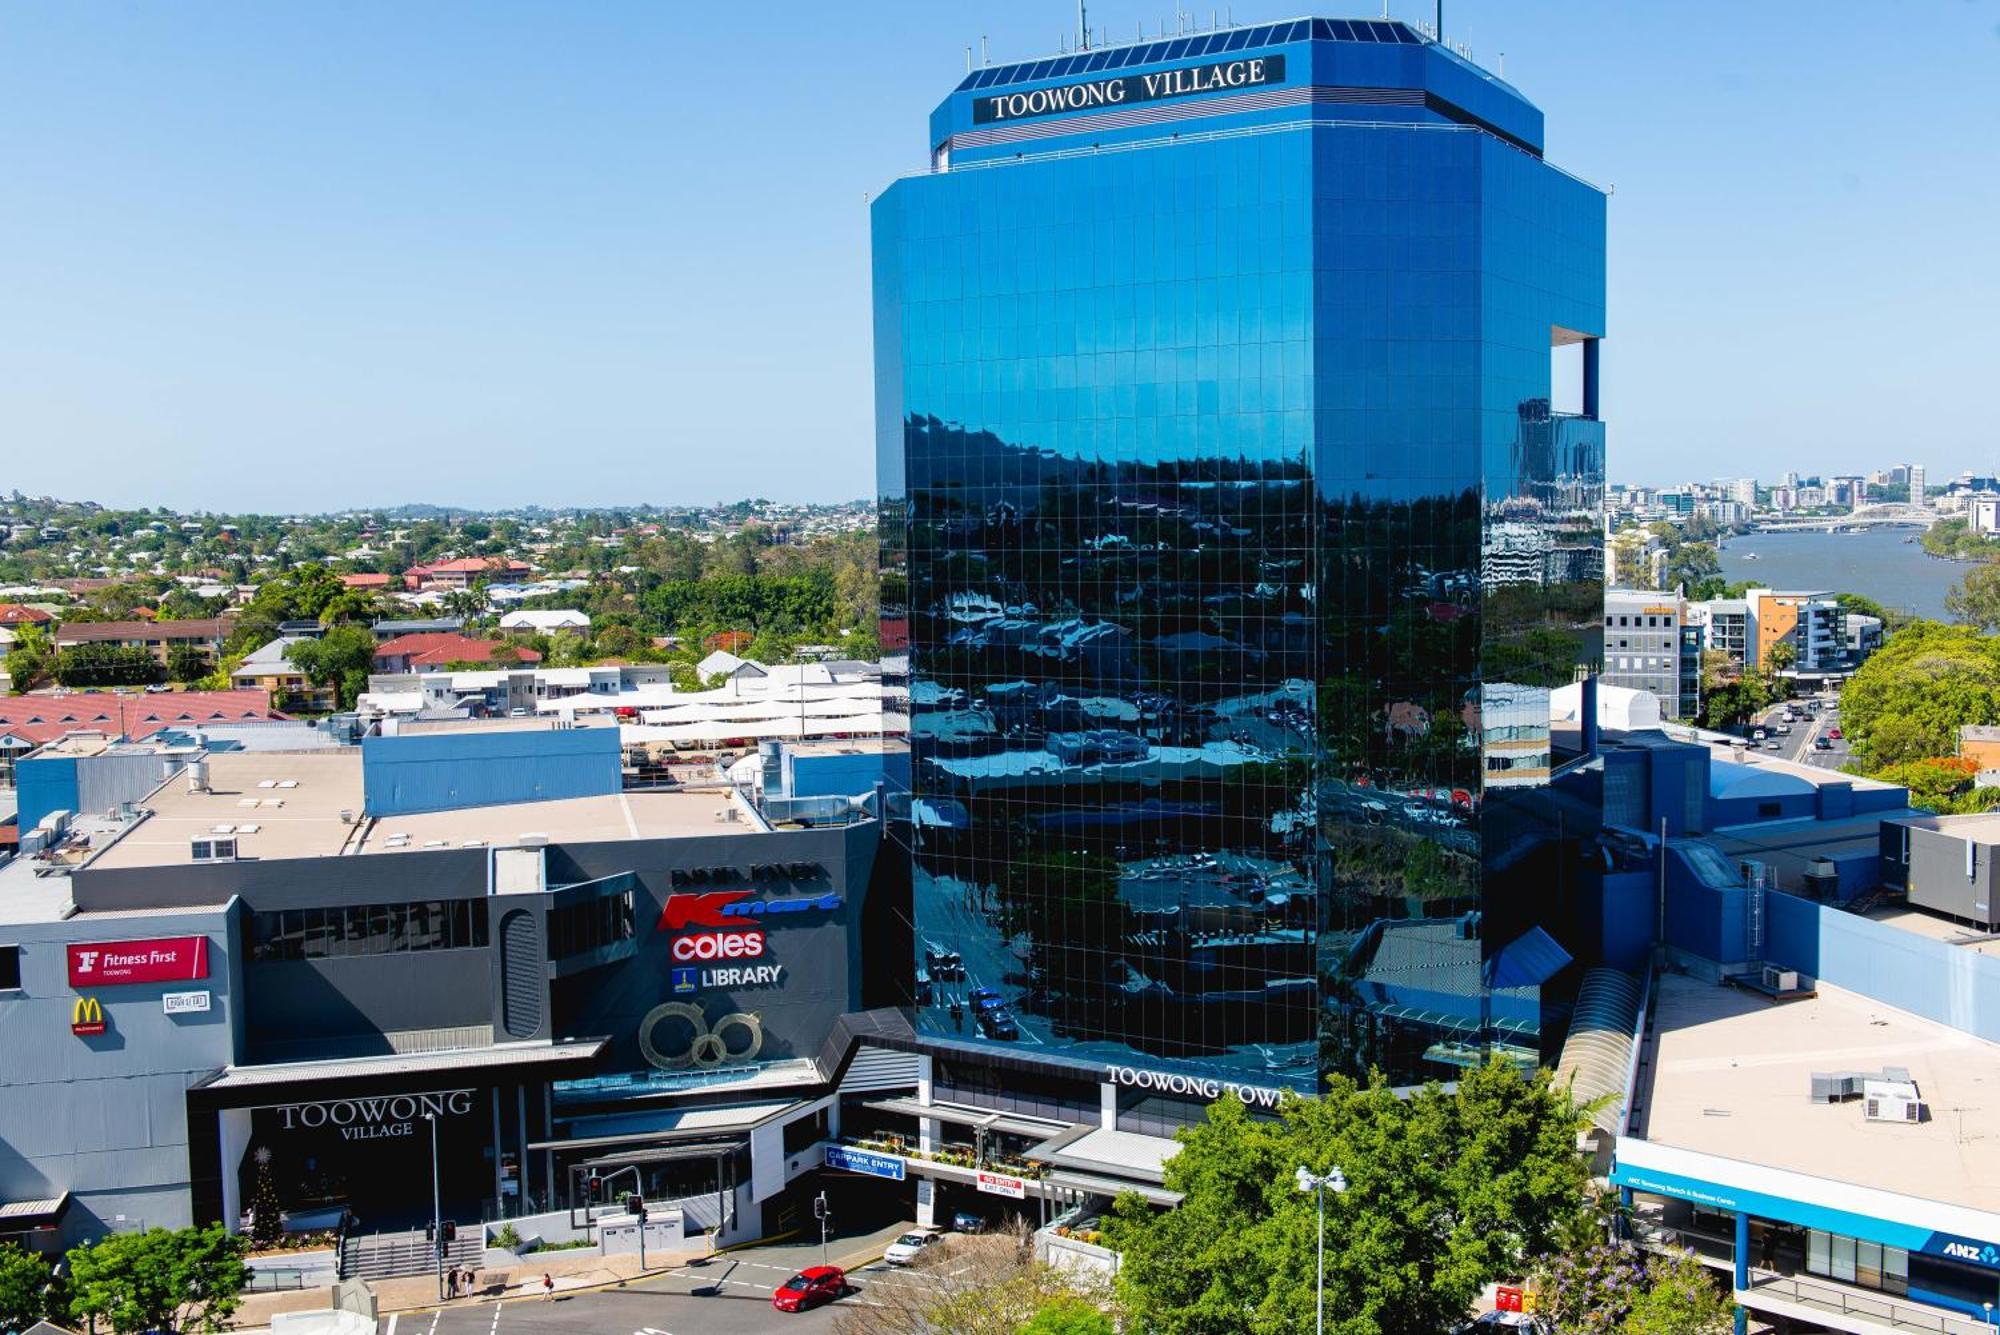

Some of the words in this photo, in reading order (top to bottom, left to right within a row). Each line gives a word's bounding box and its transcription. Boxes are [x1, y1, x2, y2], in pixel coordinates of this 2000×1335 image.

[990, 79, 1126, 119] TOOWONG
[1143, 58, 1265, 97] VILLAGE
[657, 889, 843, 931] Kmart
[672, 932, 763, 961] coles
[702, 965, 783, 987] LIBRARY
[1106, 1064, 1219, 1099] TOOWONG
[276, 1091, 473, 1130] TOOWONG
[341, 1122, 413, 1141] VILLAGE
[871, 1158, 900, 1170] ENTRY
[1943, 1242, 1980, 1261] ANZ
